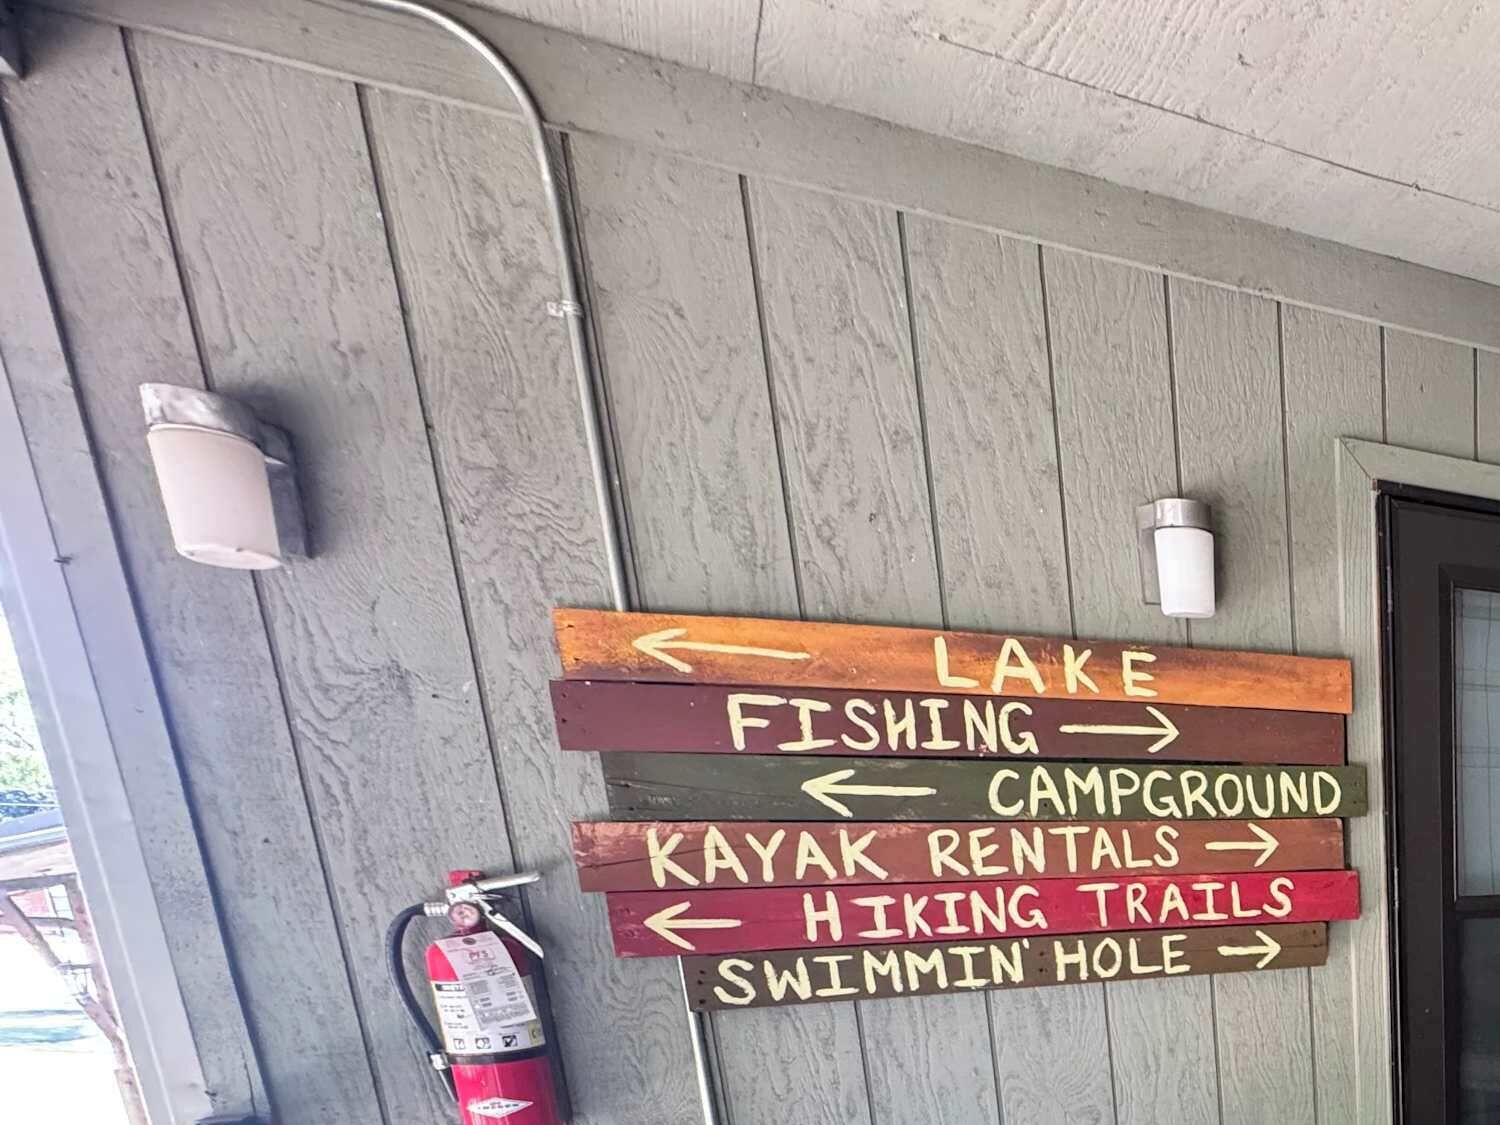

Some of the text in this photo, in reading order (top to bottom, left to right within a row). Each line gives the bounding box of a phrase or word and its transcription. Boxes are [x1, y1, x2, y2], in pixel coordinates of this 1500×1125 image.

[934, 636, 1158, 697] LAKE
[728, 693, 1040, 755] FISHING
[988, 765, 1342, 819] CAMPGROUND
[646, 824, 1181, 888] KAYAK RENTALS
[803, 876, 1295, 942] HIKING TRAILS
[1055, 934, 1192, 982] HOLE
